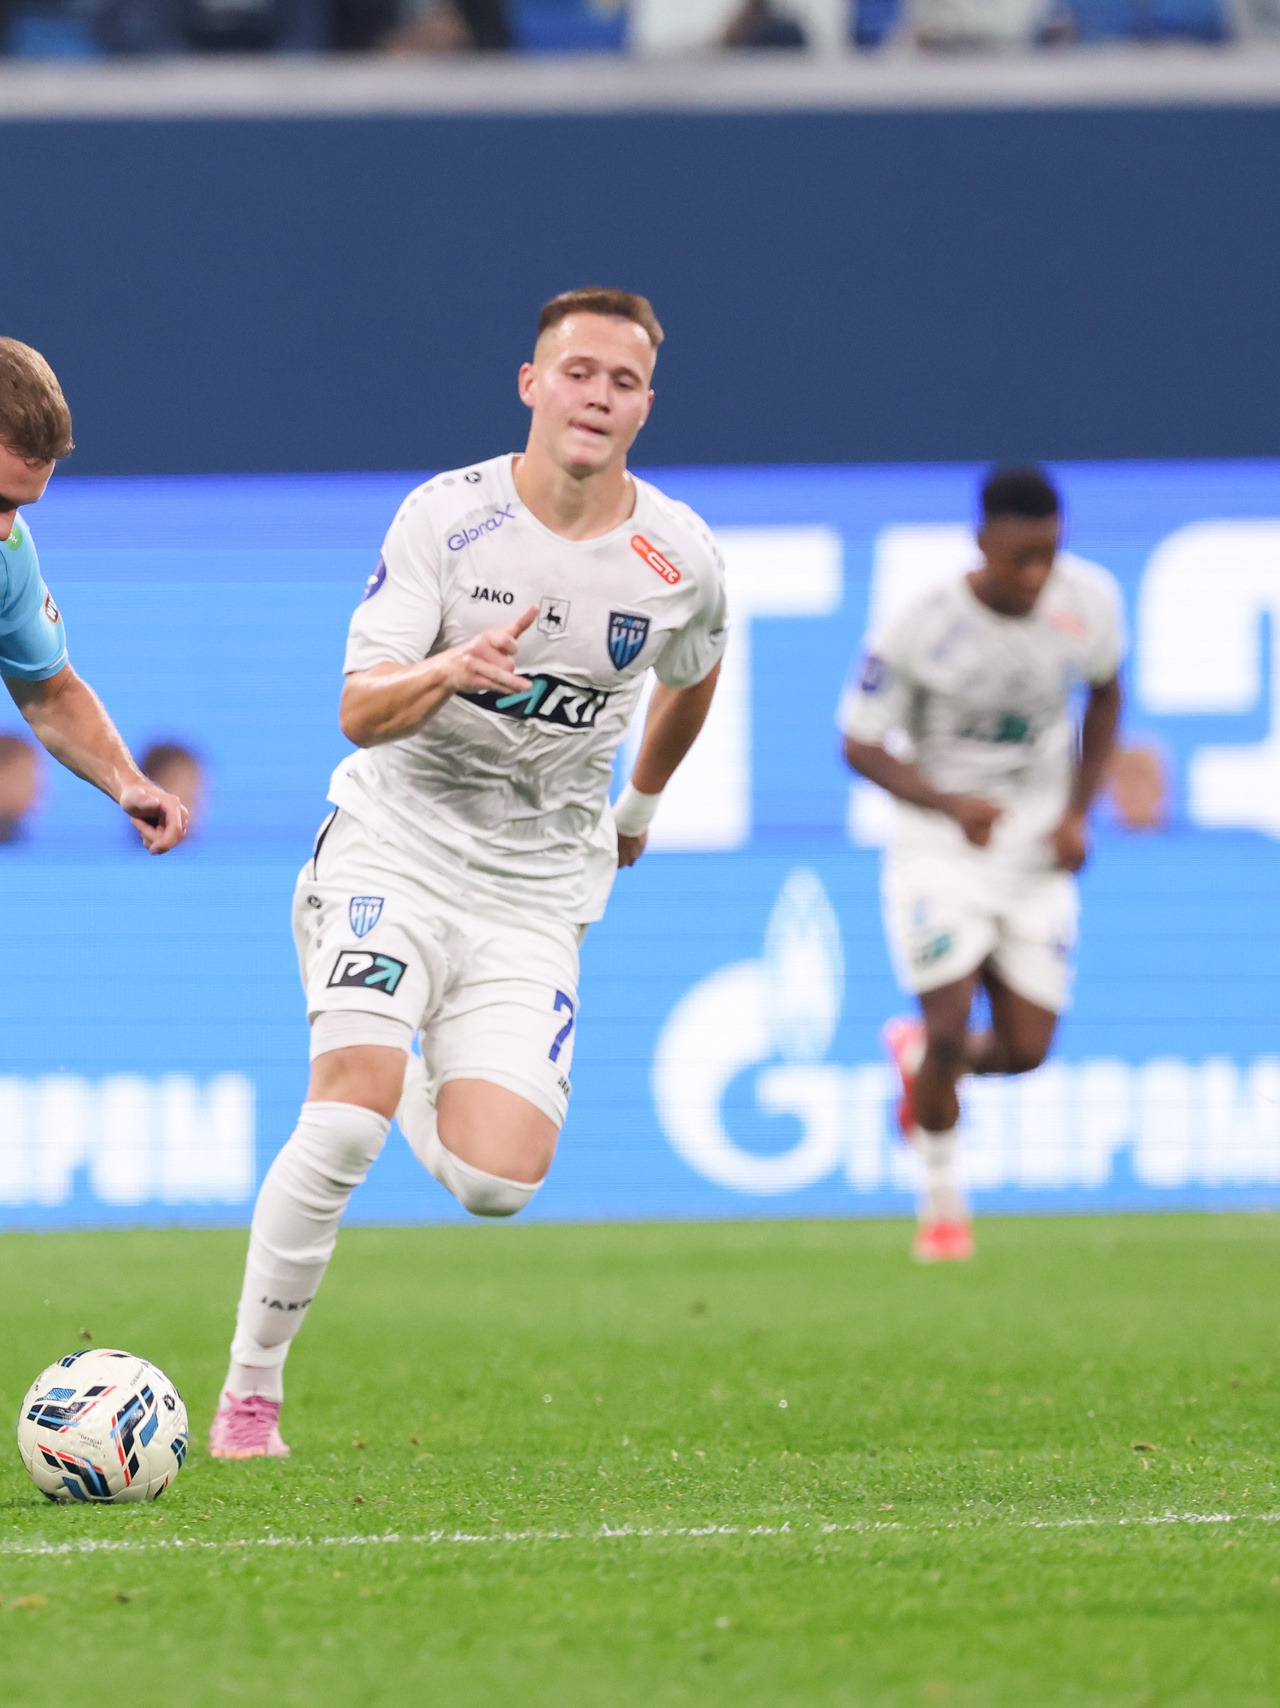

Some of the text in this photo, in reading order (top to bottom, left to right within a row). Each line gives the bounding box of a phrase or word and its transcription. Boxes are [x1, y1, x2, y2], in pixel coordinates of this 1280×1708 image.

[447, 503, 516, 553] GloraX
[470, 584, 515, 606] JAKO
[478, 678, 605, 724] ARI
[548, 989, 574, 1064] 7
[844, 1054, 1280, 1193] ГЗПРОМ
